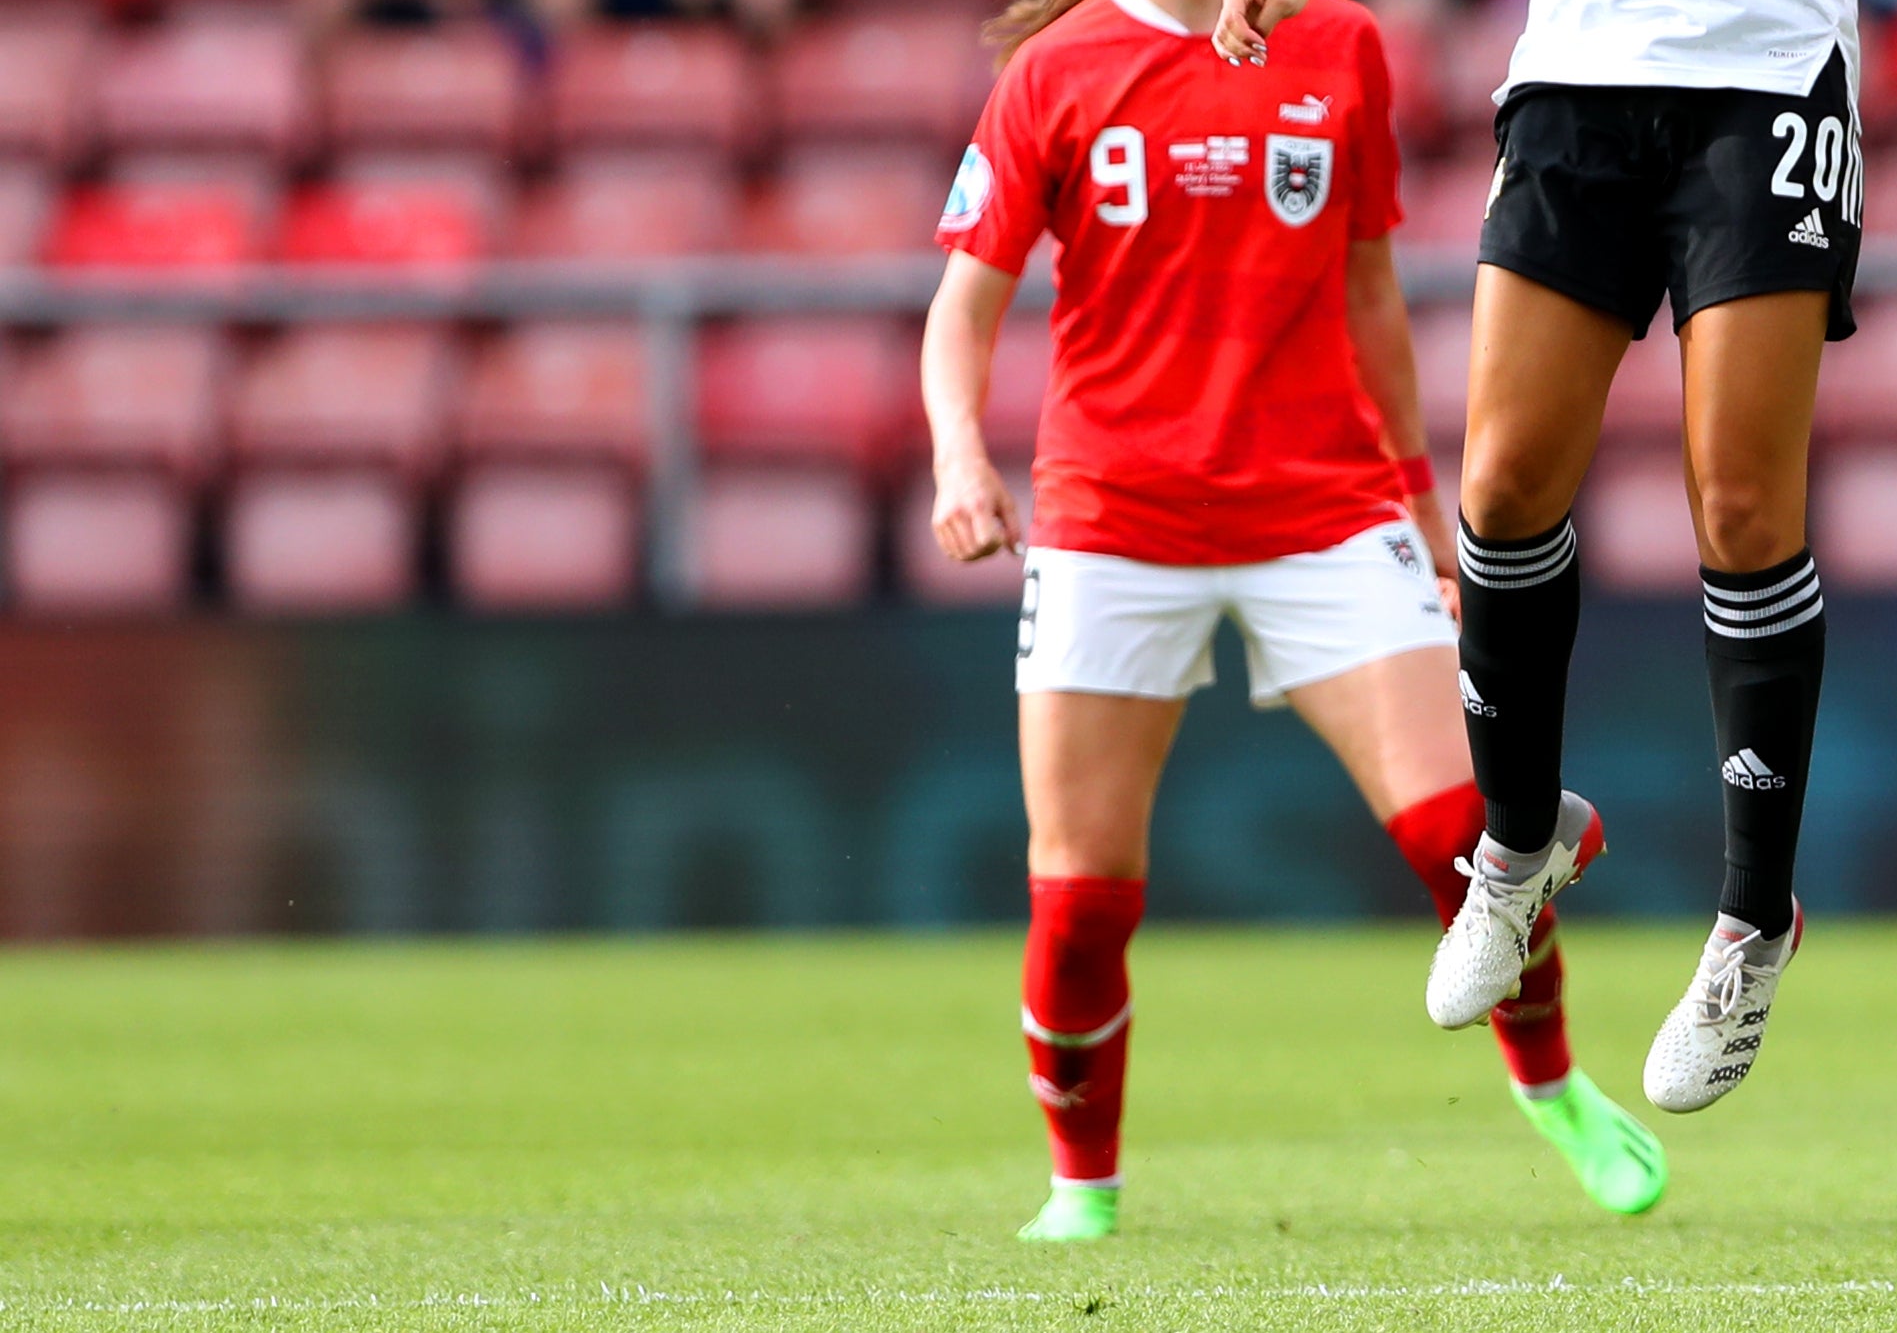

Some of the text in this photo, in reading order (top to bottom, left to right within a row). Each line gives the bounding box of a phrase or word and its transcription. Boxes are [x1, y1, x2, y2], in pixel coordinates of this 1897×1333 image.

[1091, 125, 1148, 227] 9
[1771, 111, 1844, 202] 20
[1788, 230, 1829, 249] adidas
[1722, 766, 1786, 790] adidas
